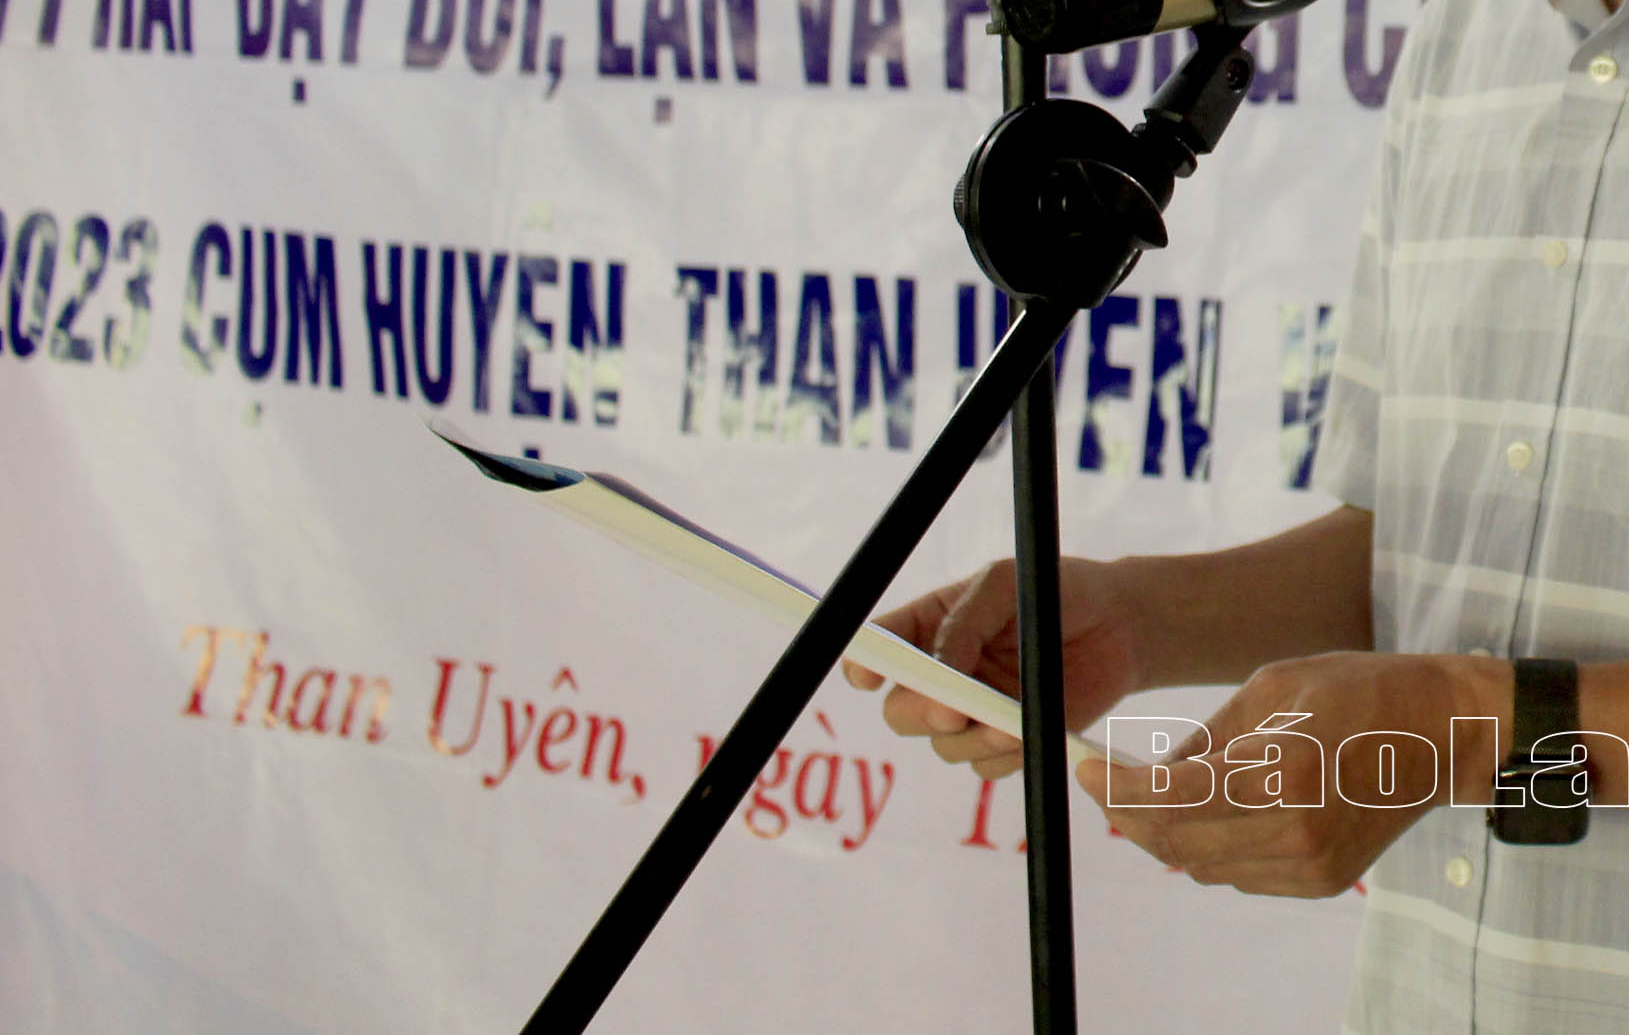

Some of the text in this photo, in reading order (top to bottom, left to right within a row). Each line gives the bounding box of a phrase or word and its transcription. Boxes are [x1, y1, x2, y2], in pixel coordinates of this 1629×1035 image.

[0, 208, 160, 371] 023
[180, 220, 344, 426] CỤM
[676, 263, 917, 452] THAN
[181, 625, 392, 744] Than
[428, 656, 647, 805] Uyên,
